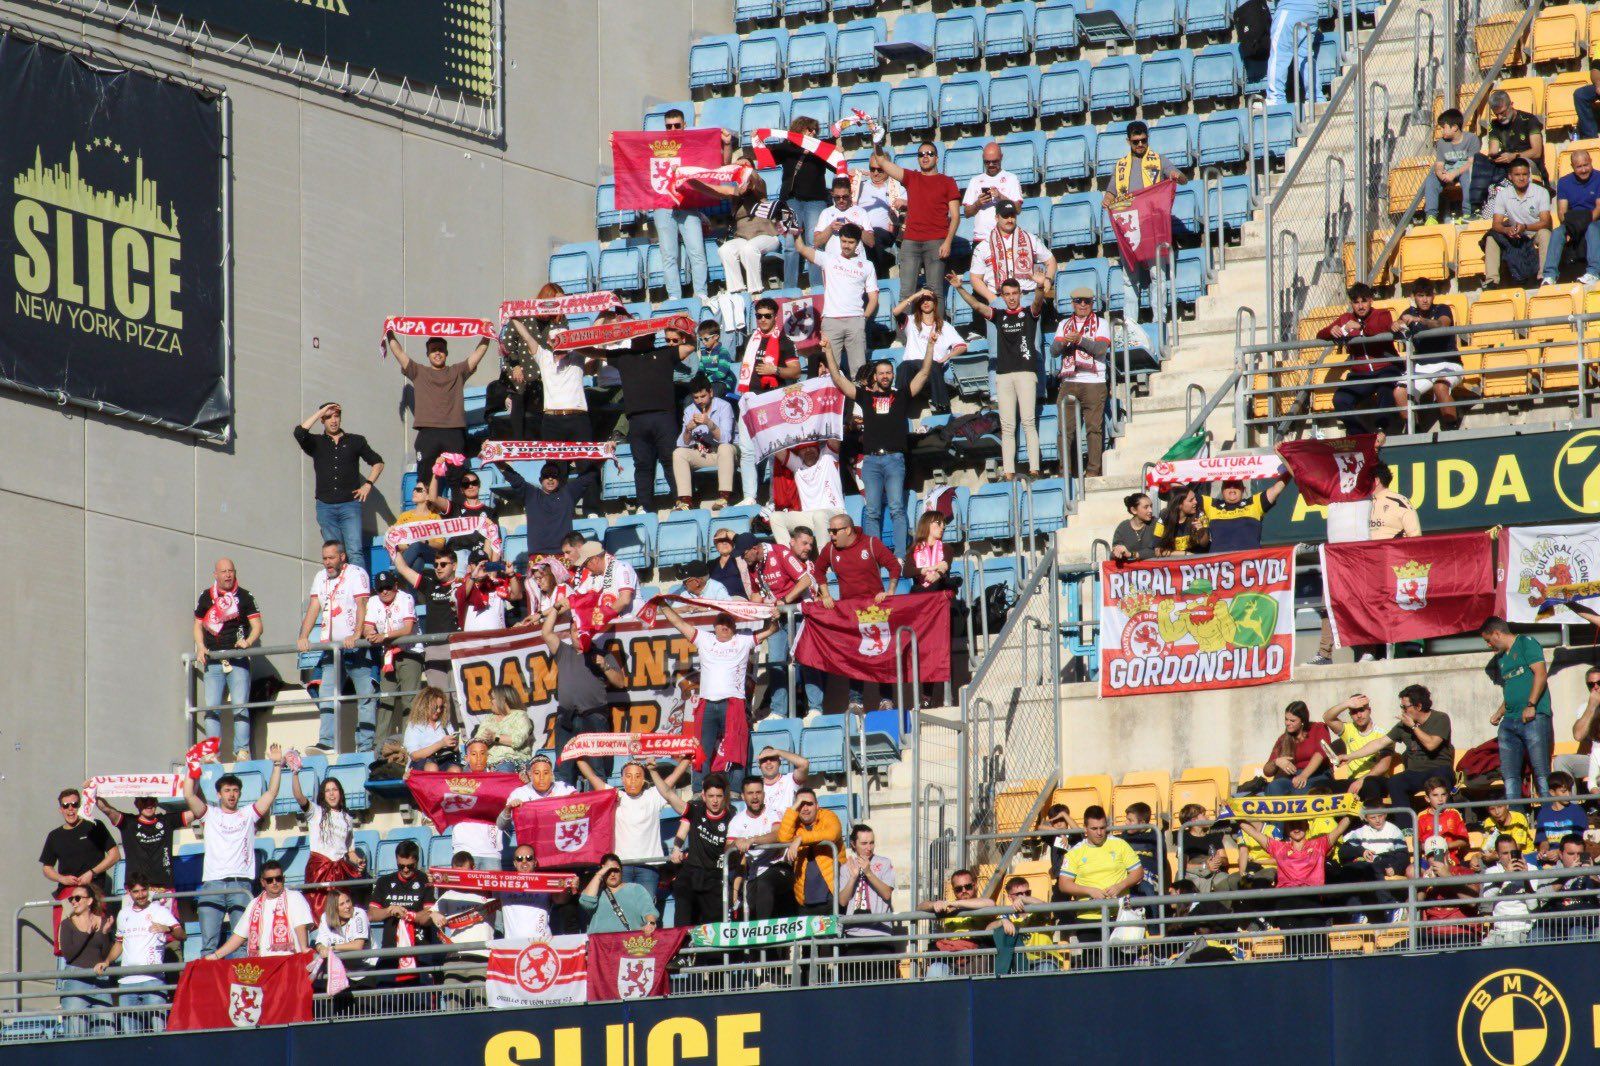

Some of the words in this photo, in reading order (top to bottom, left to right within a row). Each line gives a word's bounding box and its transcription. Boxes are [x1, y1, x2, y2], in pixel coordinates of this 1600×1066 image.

[13, 198, 183, 330] SLICE
[15, 291, 62, 325] NEW
[67, 305, 122, 341] YORK
[126, 320, 183, 356] PIZZA
[431, 321, 480, 335] CULTU
[1199, 455, 1264, 468] CULTURAL
[1535, 544, 1573, 576] CULTURAL
[1573, 554, 1590, 584] LEONE
[1109, 567, 1177, 599] RURAL
[1179, 562, 1236, 592] BOYS
[460, 634, 699, 716] RAMANT
[1109, 644, 1285, 690] GORDONCILLO
[645, 738, 694, 749] LEONES
[95, 775, 169, 785] ULTURAL
[1311, 796, 1347, 812] C.F.
[467, 872, 498, 880] CULTURAL
[477, 879, 529, 889] LEONESA
[386, 893, 419, 902] ASPIRE
[723, 928, 738, 939] CD
[742, 920, 803, 938] VALDERAS
[1471, 975, 1554, 1012] BMW
